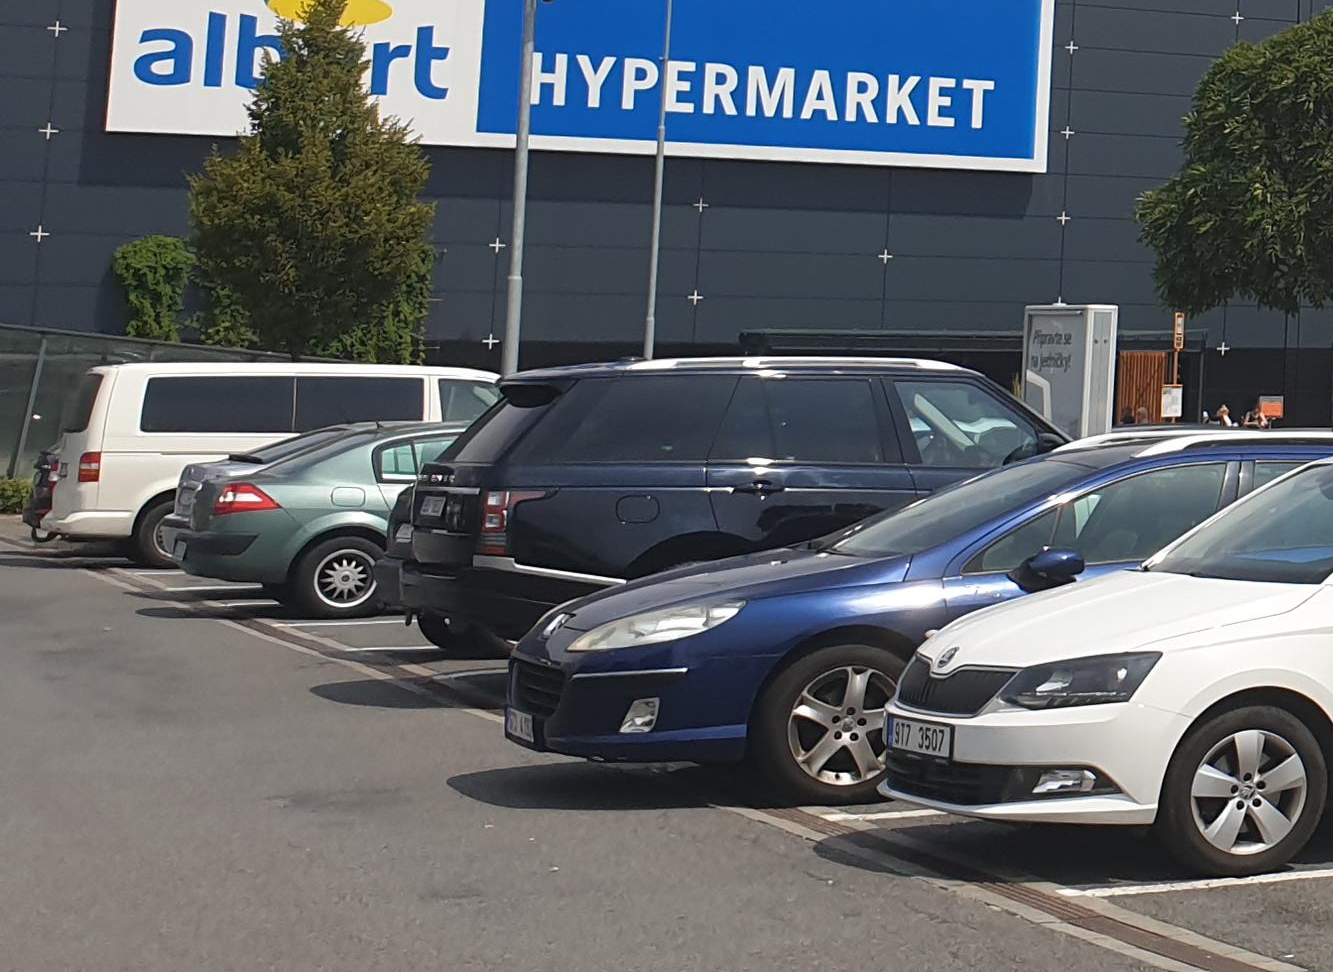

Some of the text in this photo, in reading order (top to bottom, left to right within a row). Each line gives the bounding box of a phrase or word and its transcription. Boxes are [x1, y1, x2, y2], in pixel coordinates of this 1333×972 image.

[133, 11, 450, 100] albrt
[530, 54, 995, 130] HYPERMARKET
[894, 722, 945, 753] 9T7 3507
